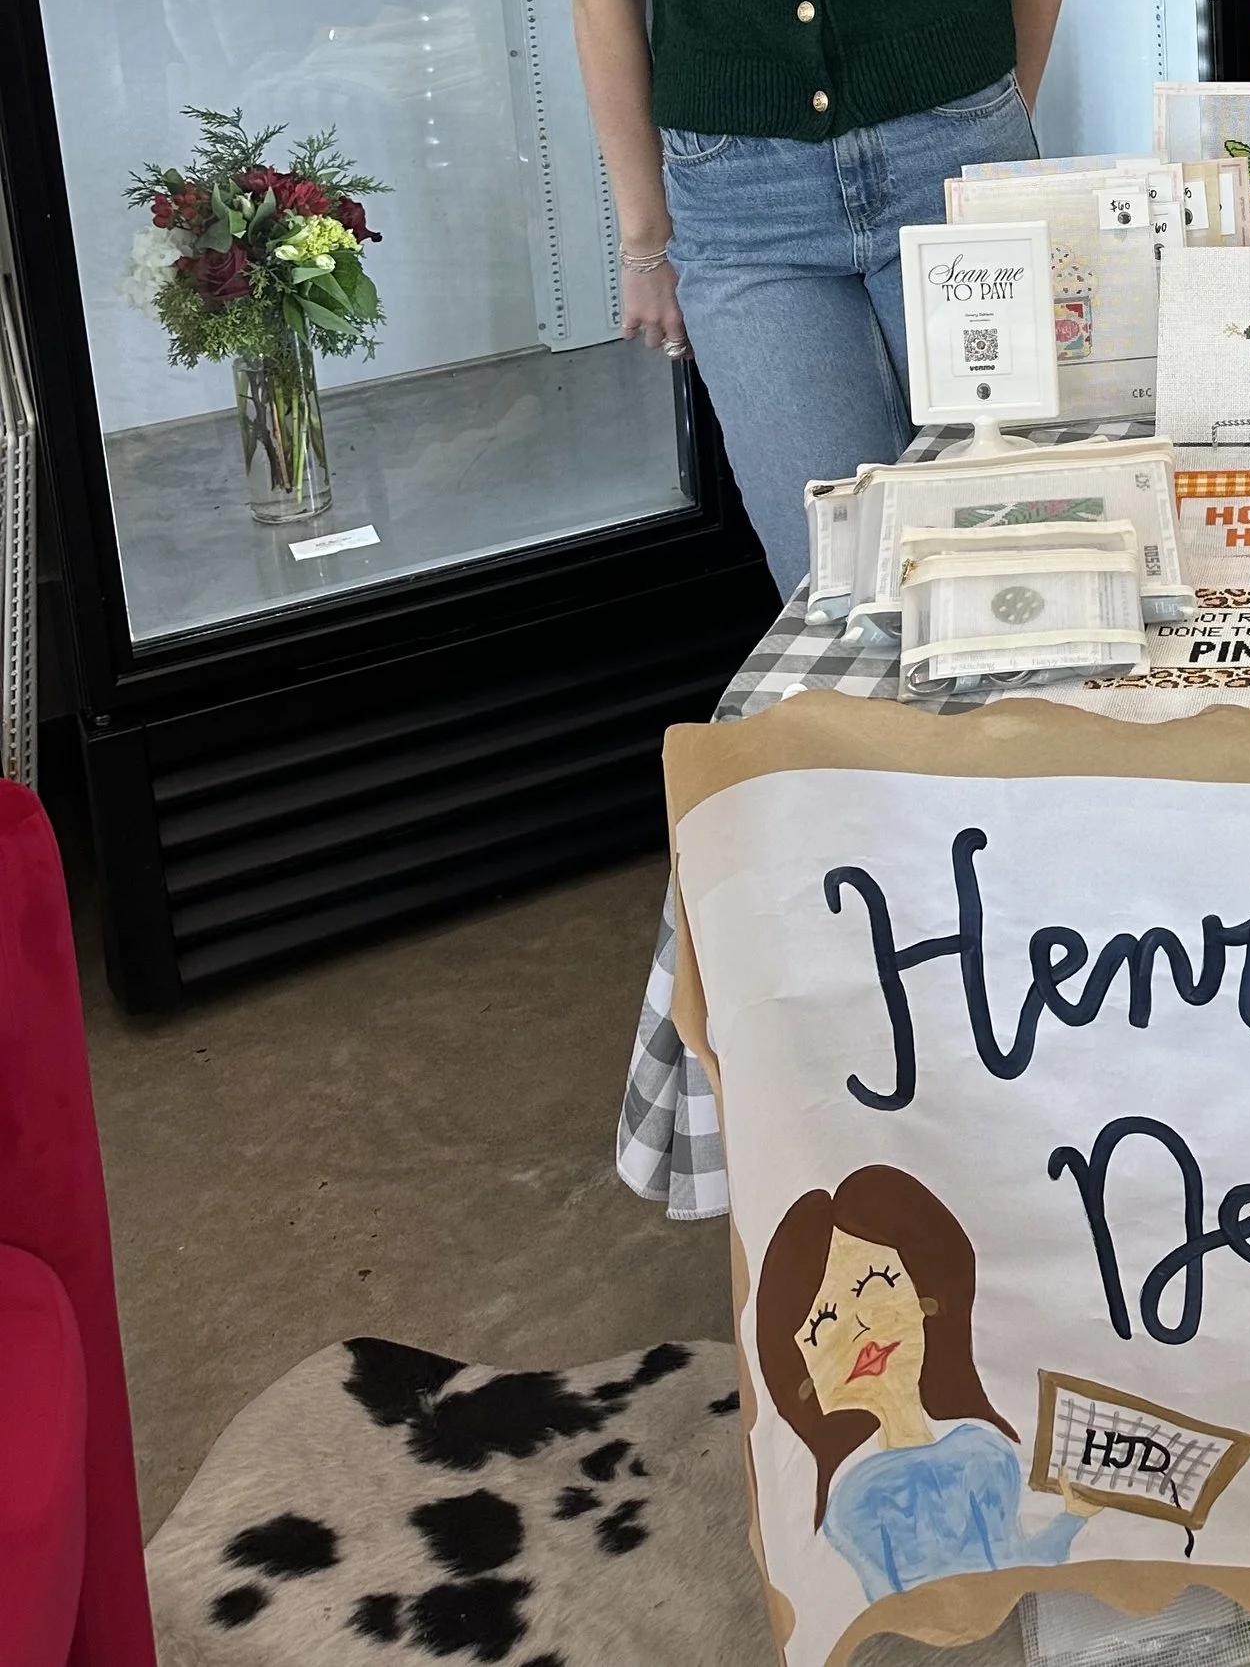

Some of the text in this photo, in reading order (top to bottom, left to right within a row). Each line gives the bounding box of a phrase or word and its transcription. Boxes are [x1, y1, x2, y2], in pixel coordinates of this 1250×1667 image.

[1110, 200, 1131, 212] $60
[928, 254, 1025, 285] Scan me
[942, 282, 1014, 301] TO PAY!
[969, 364, 996, 372] venmo
[1158, 626, 1223, 637] DONE
[1081, 1427, 1172, 1475] HJD
